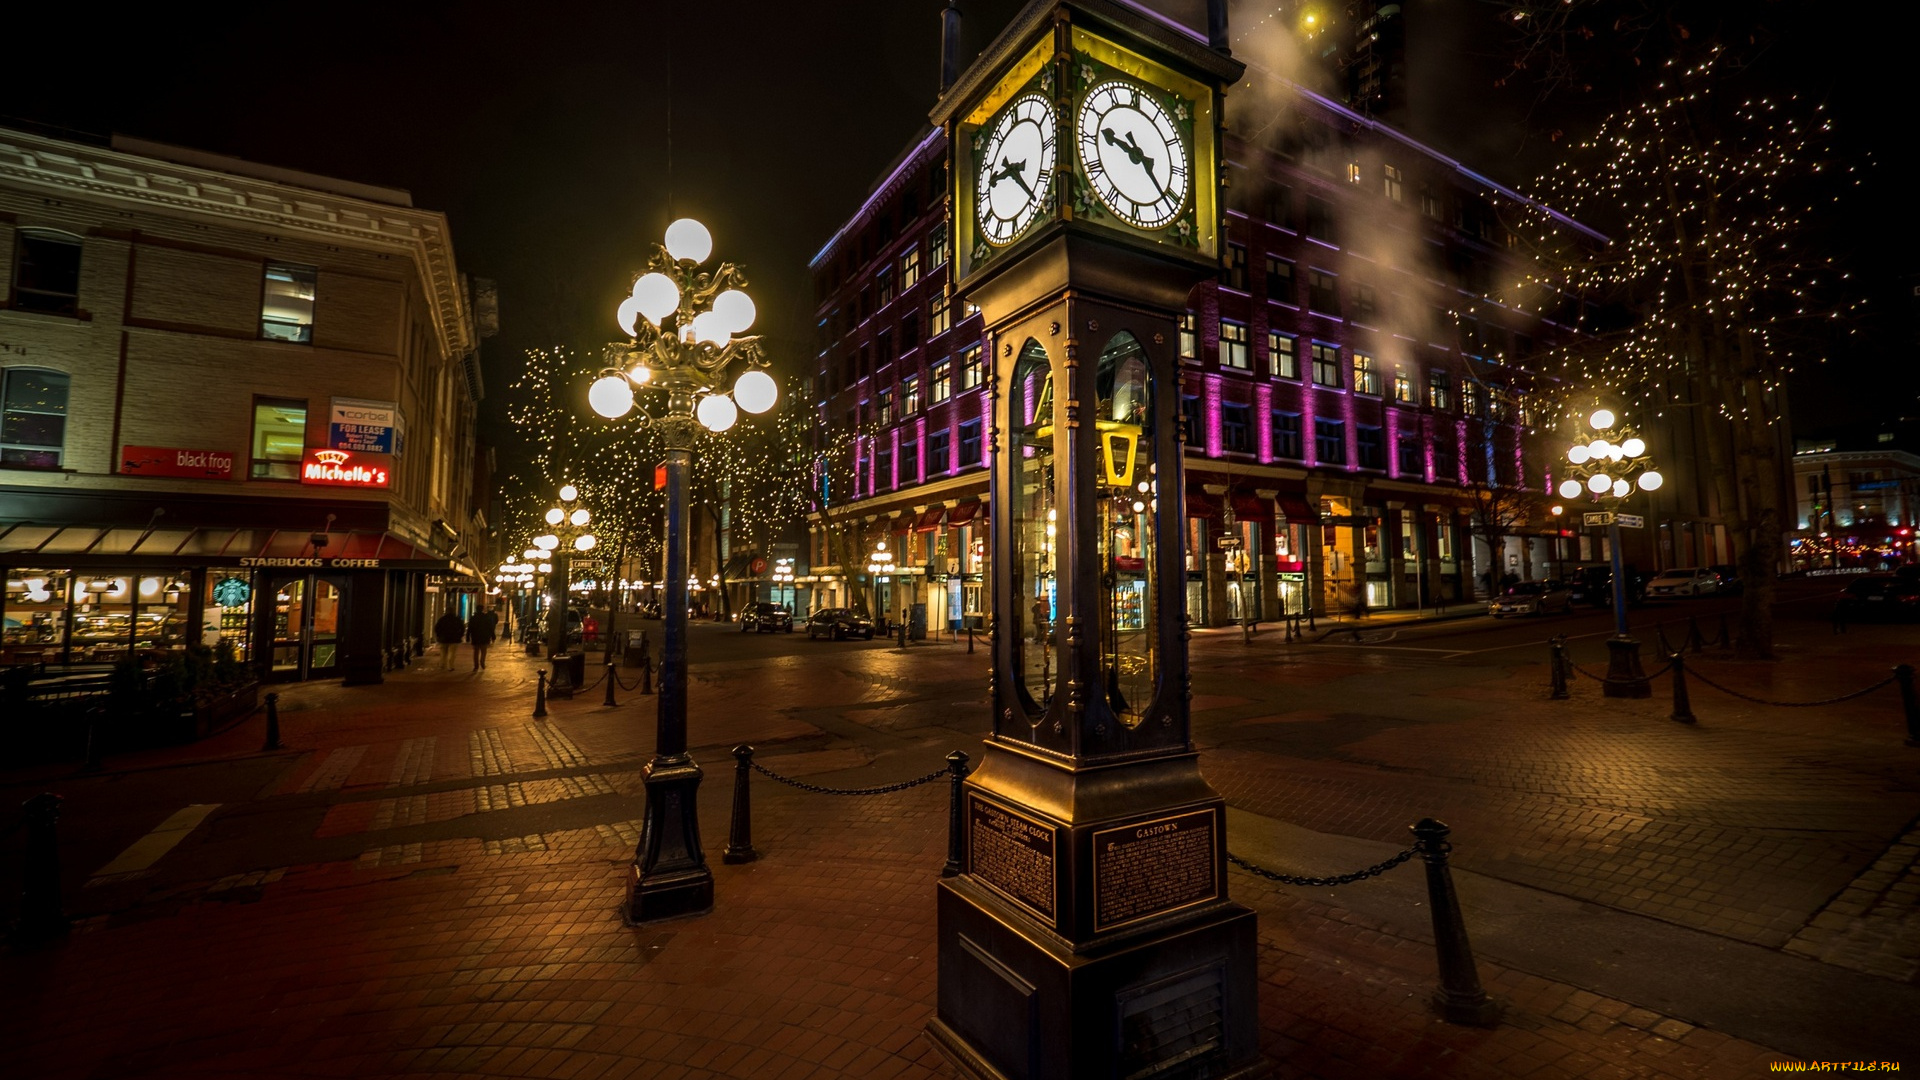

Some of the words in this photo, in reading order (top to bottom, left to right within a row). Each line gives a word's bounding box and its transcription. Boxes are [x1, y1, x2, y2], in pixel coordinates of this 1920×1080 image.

[346, 411, 389, 421] corbel
[339, 424, 357, 433] FOR
[358, 425, 386, 436] LEASE
[177, 451, 207, 467] black
[208, 452, 232, 473] frog
[305, 463, 385, 483] Michelle's
[239, 557, 323, 567] STARBUCKS
[331, 558, 380, 568] COFFEE
[1028, 825, 1050, 842] CLOCK
[1136, 822, 1178, 839] GASTOWN
